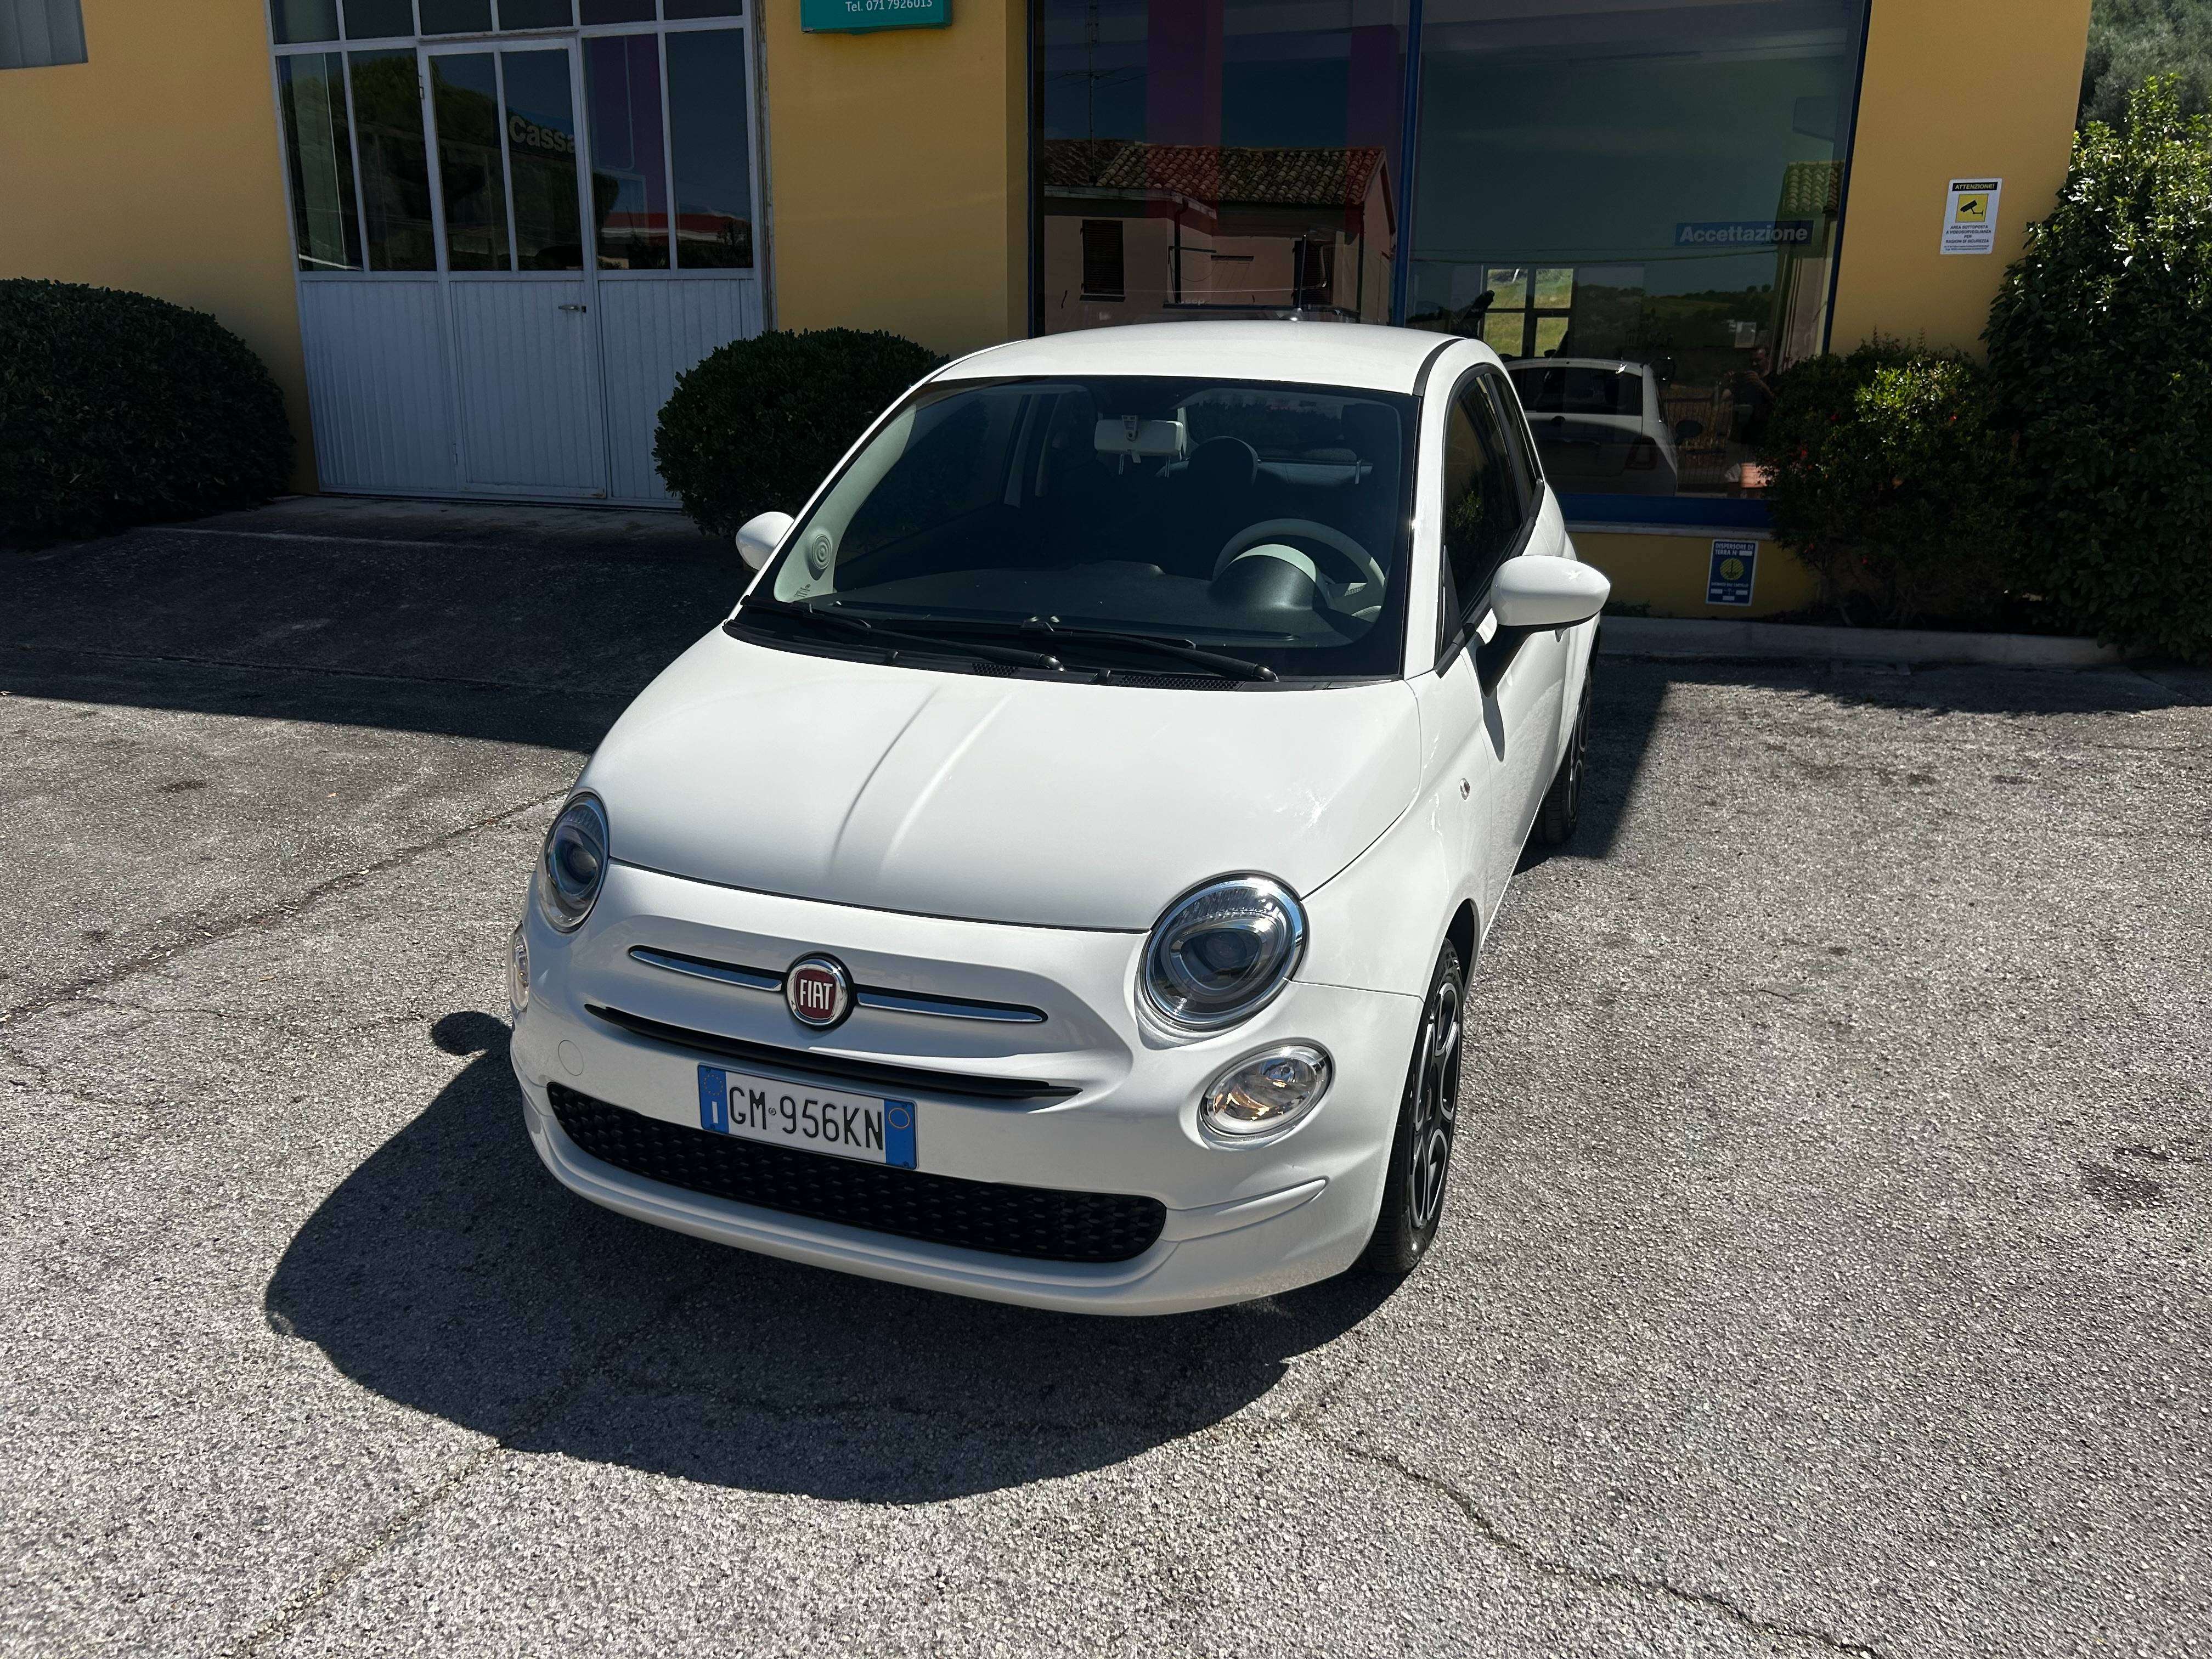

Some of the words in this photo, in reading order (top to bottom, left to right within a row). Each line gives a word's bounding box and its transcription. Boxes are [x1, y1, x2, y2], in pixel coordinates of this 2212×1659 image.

[845, 1, 863, 12] Tel.
[866, 0, 884, 10] 071
[1679, 224, 1808, 242] Accettazione
[799, 978, 833, 1010] FIAT
